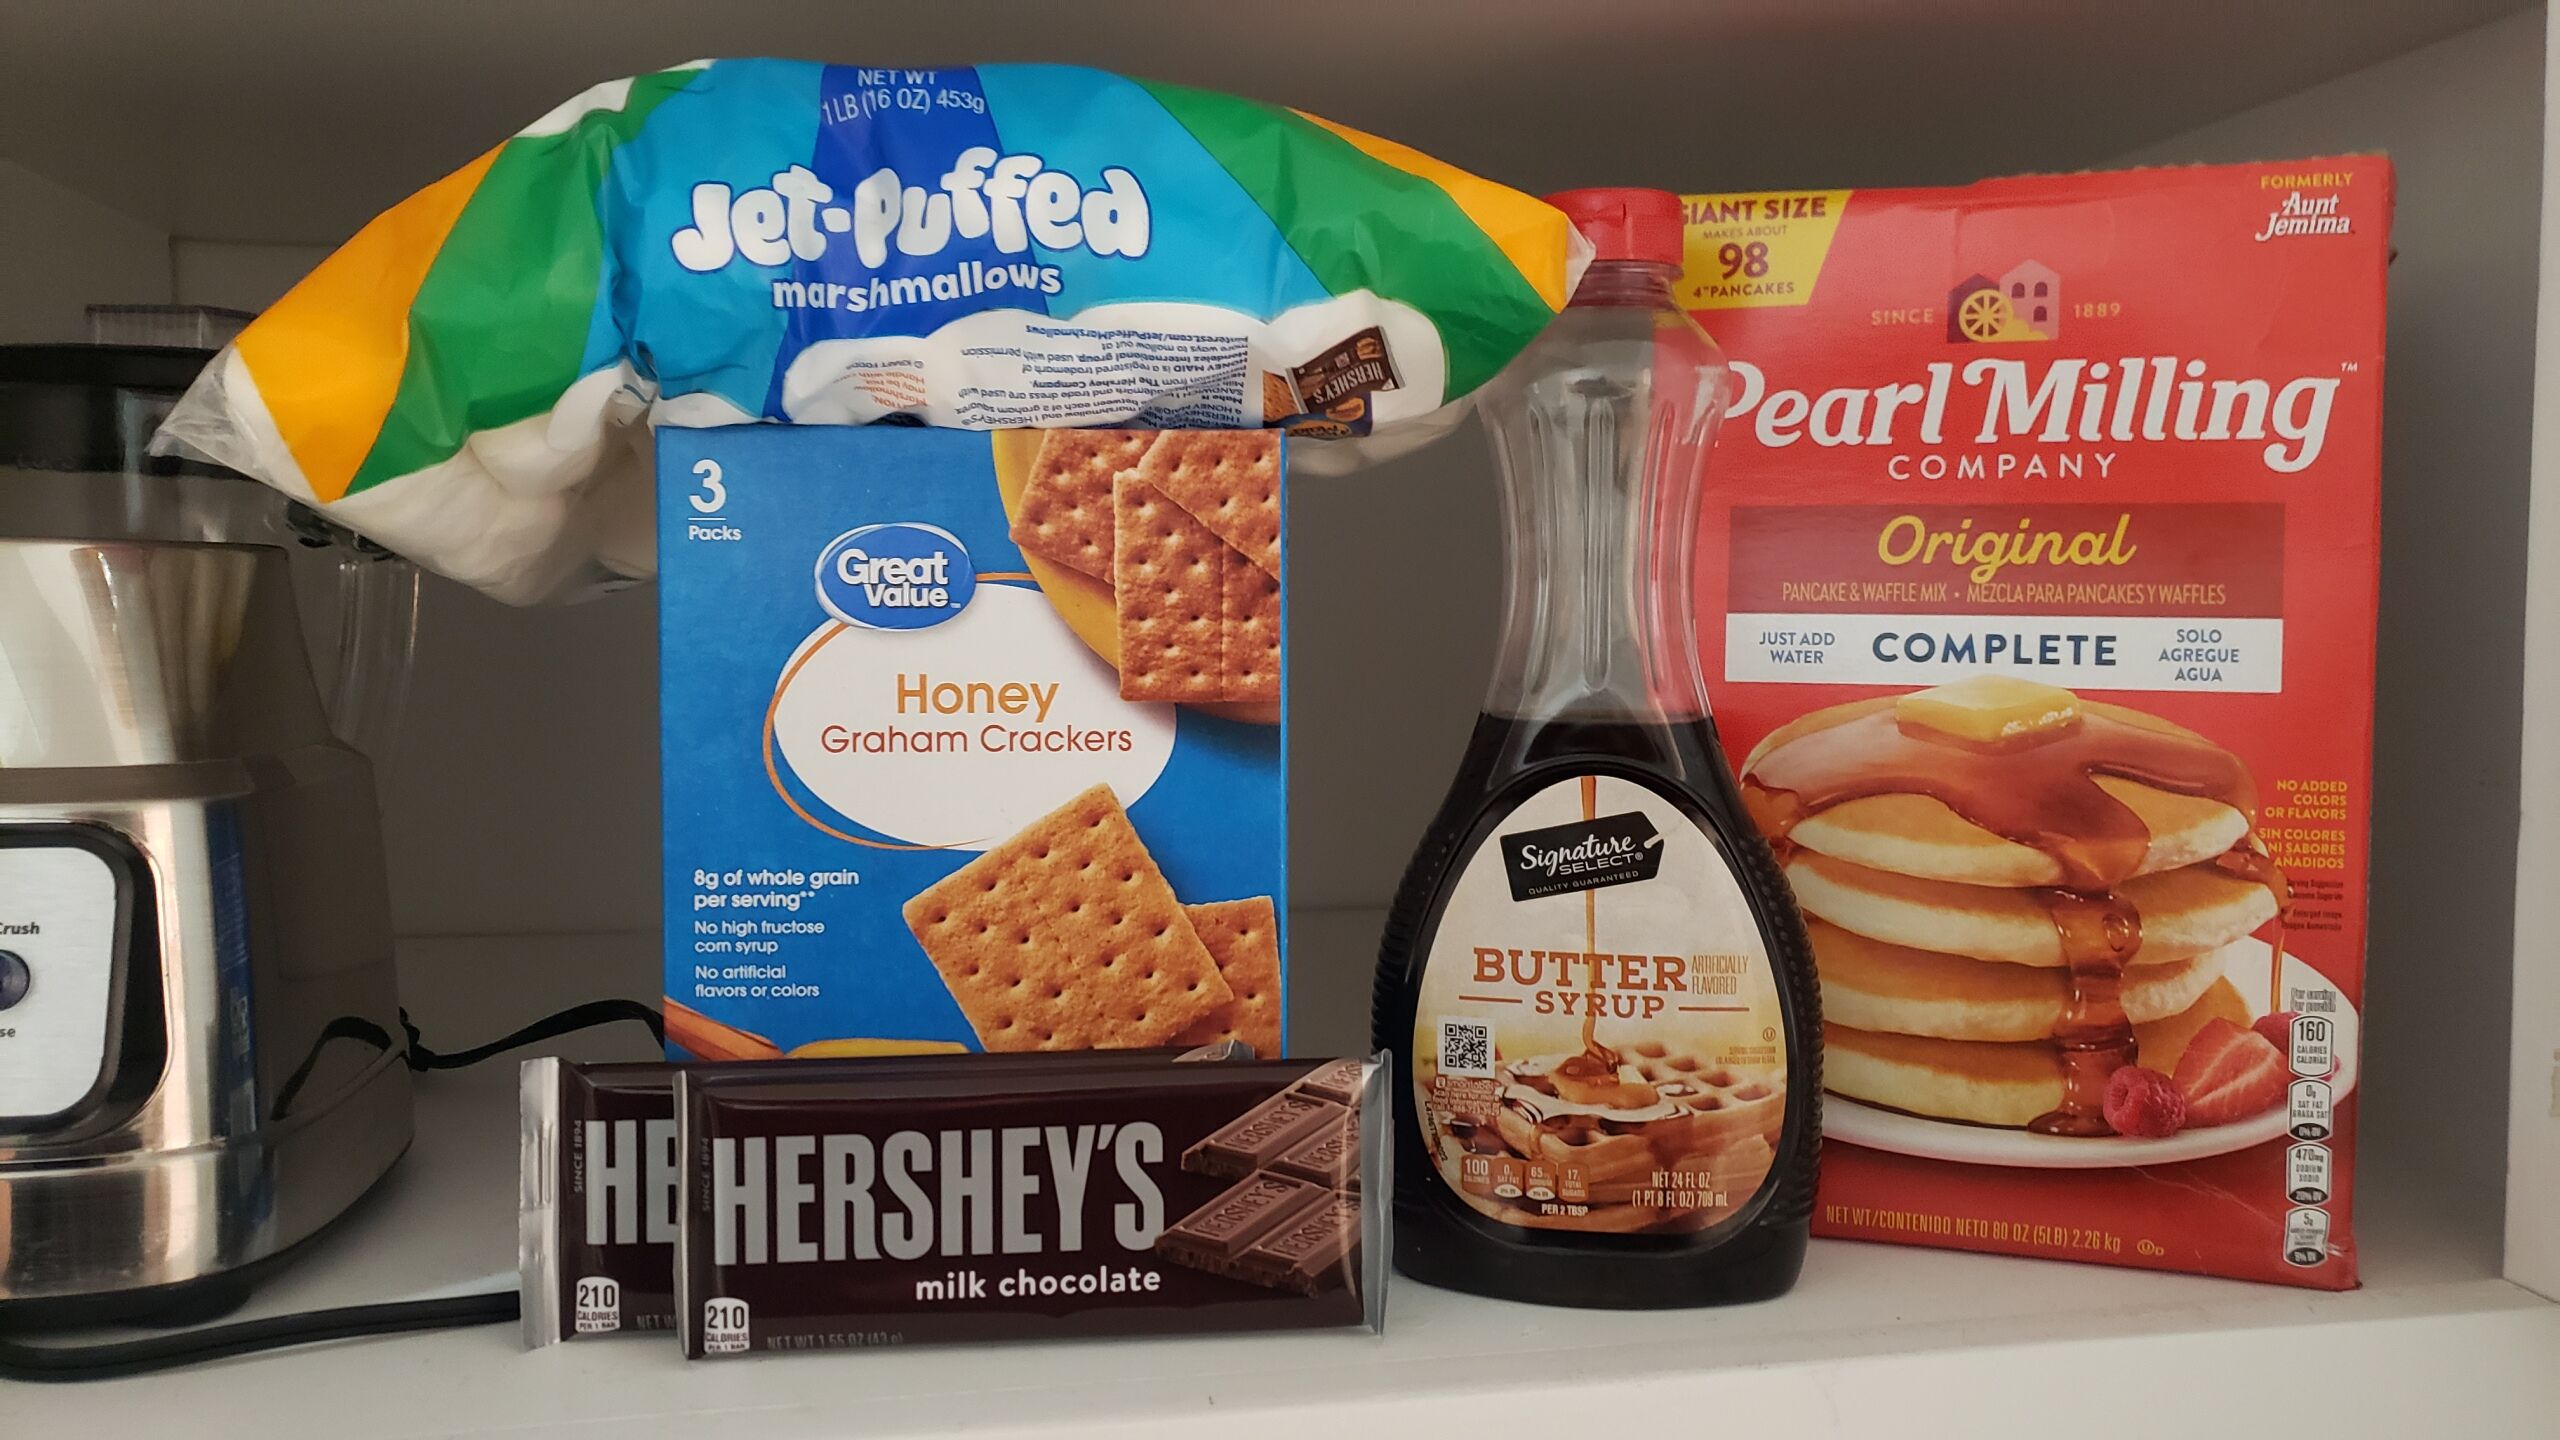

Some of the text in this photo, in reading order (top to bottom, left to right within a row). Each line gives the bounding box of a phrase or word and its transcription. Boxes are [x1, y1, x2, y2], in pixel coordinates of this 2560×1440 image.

[857, 69, 937, 87] NET WT
[822, 88, 985, 125] 1 LB (16 OZ) 453g
[2260, 172, 2353, 189] FORMERLY
[1764, 197, 1828, 219] SIZE
[2282, 191, 2340, 216] Aunt
[1703, 225, 1787, 239] MAKES ABOUT
[2254, 212, 2351, 241] Jemima
[1718, 241, 1768, 280] 98
[771, 262, 1062, 312] marshmallows
[1871, 307, 1934, 327] SINCE
[2072, 301, 2121, 319] 1889
[1101, 342, 1114, 350] at
[1136, 341, 1174, 352] mallow
[1177, 346, 1188, 354] to
[1190, 344, 1218, 352] ways
[1023, 350, 1045, 361] with
[1047, 353, 1074, 364] used
[1114, 352, 1191, 364] International
[1022, 358, 1248, 376] HONEY MAID is registered trademark of
[1089, 377, 1136, 388] Hershey
[1139, 377, 1159, 388] The
[1313, 361, 1384, 404] HERSHEY'S
[981, 389, 1058, 401] dress are used
[998, 404, 1040, 415] graham
[1065, 402, 1090, 411] each
[1686, 357, 2341, 473] Pearl Milling
[1888, 453, 2117, 481] COMPANY
[689, 458, 727, 514] 3
[687, 524, 742, 543] Packs
[1877, 514, 2138, 584] Original
[837, 547, 949, 587] Great
[863, 582, 949, 609] Value
[1782, 581, 1947, 603] PANCAKE & WAFFLE MIX
[1966, 583, 2226, 606] MEZCLA PARA PANCAKES Y WAFFLES
[1759, 631, 1835, 647] JUST ADD
[2175, 628, 2223, 645] SOLO
[1770, 650, 1824, 665] WATER
[1872, 631, 2118, 667] COMPLETE
[2158, 647, 2240, 664] AGREGUE
[2174, 666, 2223, 683] AGUA
[896, 673, 1060, 724] Honey
[820, 724, 1133, 753] Graham Crackers
[2277, 780, 2348, 793] NO ADDED
[2293, 794, 2347, 806] COLORS
[2265, 807, 2347, 821] OR FLAVORS
[2259, 828, 2346, 842] SIN COLORES
[1520, 833, 1638, 877] Signature
[2268, 842, 2345, 856] NI SABORES
[2273, 855, 2345, 869] AÑADIDOS
[694, 868, 860, 890] 8g of whole grain
[1527, 869, 1639, 896] QUALITY GUARANTEED
[693, 893, 728, 912] per
[694, 920, 825, 937] No high fructose
[694, 941, 779, 955] corn syrup
[695, 965, 786, 979] No artificial
[1472, 947, 1688, 993] BUTTER
[1691, 954, 1749, 974] ARTIFICIALLY
[695, 984, 820, 998] flavors or colors
[1691, 974, 1737, 995] FLAVORED
[1535, 990, 1665, 1020] SYRUP
[2298, 1020, 2325, 1042] 160
[574, 1120, 583, 1192] SINCE 1894
[1465, 1159, 1488, 1175] 100
[586, 1118, 677, 1245] HE
[1652, 1171, 1711, 1188] NET 24 FL OZ
[713, 1121, 1165, 1266] HERSHEY'S
[1632, 1189, 1728, 1209] (1 PT 8 FL OZ) 709 mL
[1542, 1203, 1588, 1216] PER 2 TBSP
[1826, 1204, 2121, 1255] NET WT/CONTENIDO NETO 80 OZ (5LB) 2.26 kg
[916, 1266, 1161, 1300] milk chocolate
[580, 1284, 615, 1308] 210
[577, 1311, 618, 1321] CALORIES
[708, 1306, 745, 1330] 210
[706, 1332, 748, 1342] CALORIES
[767, 1335, 815, 1350] NET WT
